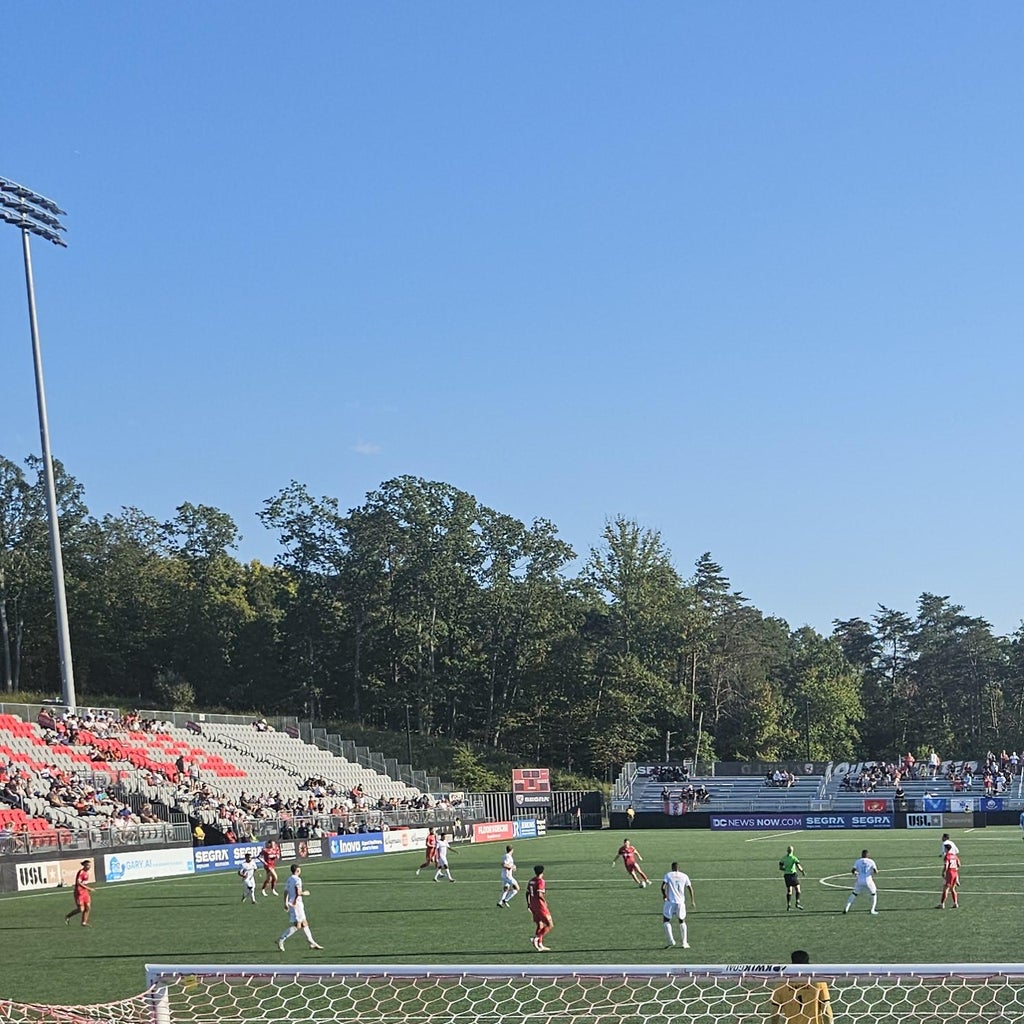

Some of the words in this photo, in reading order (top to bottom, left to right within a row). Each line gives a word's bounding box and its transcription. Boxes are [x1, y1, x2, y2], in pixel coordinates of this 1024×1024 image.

[713, 819, 727, 827] DC
[806, 817, 845, 825] SEGRA
[852, 816, 891, 824] SEGRA
[195, 849, 229, 863] SEGRA
